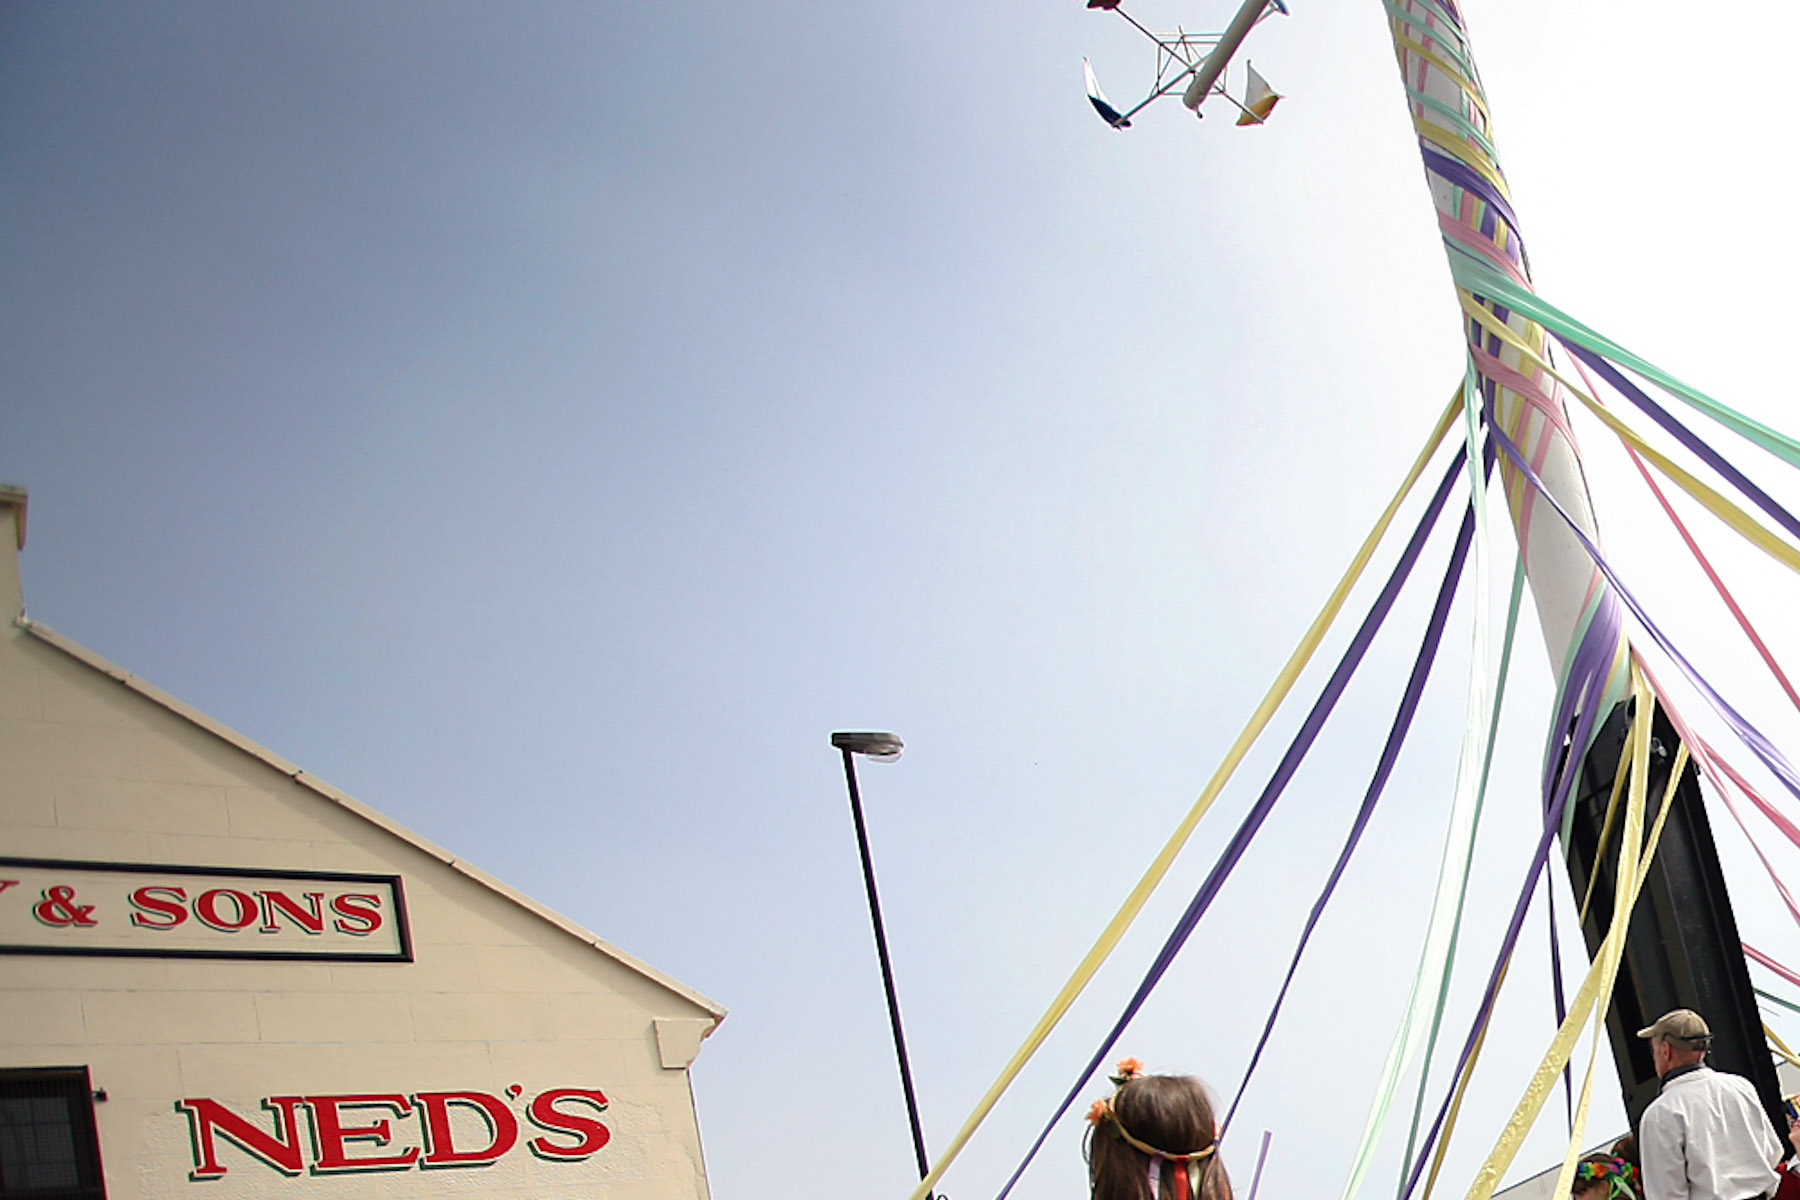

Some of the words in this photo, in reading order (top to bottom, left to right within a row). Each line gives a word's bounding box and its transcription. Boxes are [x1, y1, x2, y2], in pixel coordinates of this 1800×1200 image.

[33, 885, 98, 927] &
[128, 886, 383, 936] SONS
[174, 1084, 611, 1182] NED'S
